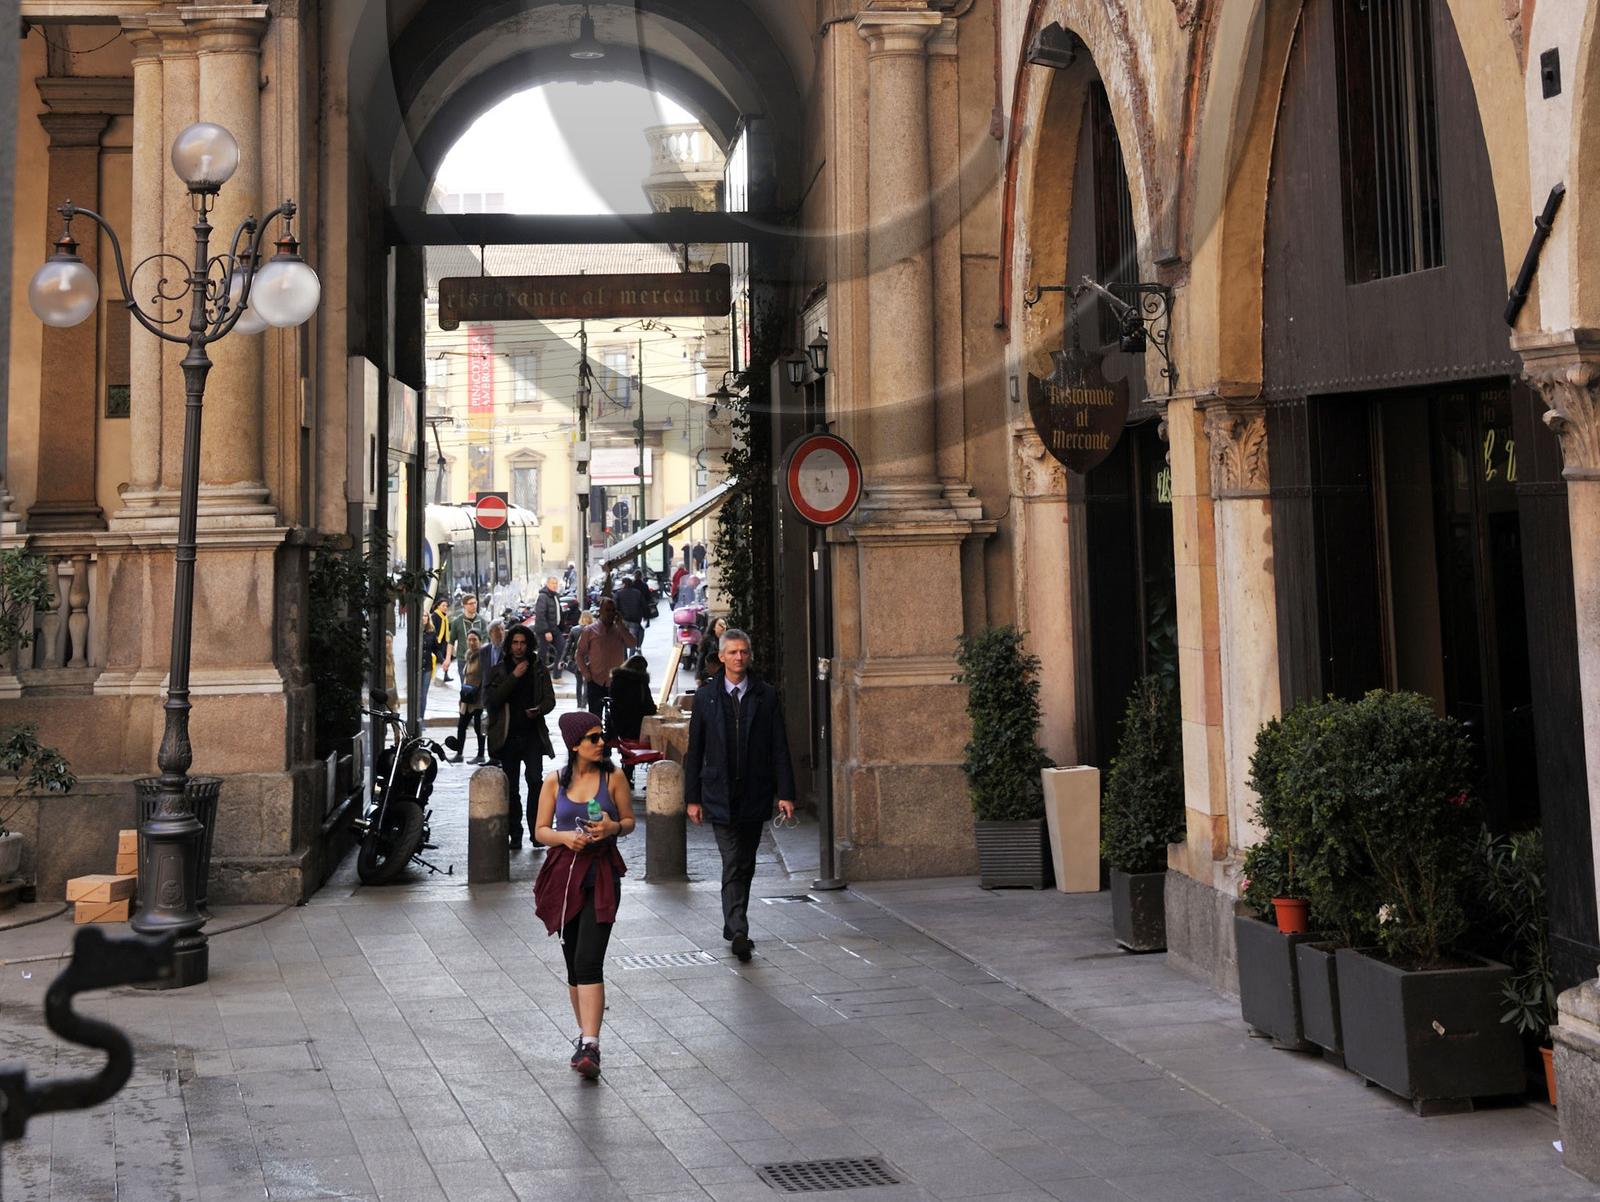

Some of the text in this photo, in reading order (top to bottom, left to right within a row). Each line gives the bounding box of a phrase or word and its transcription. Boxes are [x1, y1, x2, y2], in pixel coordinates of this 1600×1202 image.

[447, 286, 724, 309] ristorante al mercante
[481, 335, 491, 407] AMBROSANA
[1050, 386, 1115, 406] Ristorante
[1076, 408, 1088, 427] al
[1052, 430, 1110, 450] Mercante
